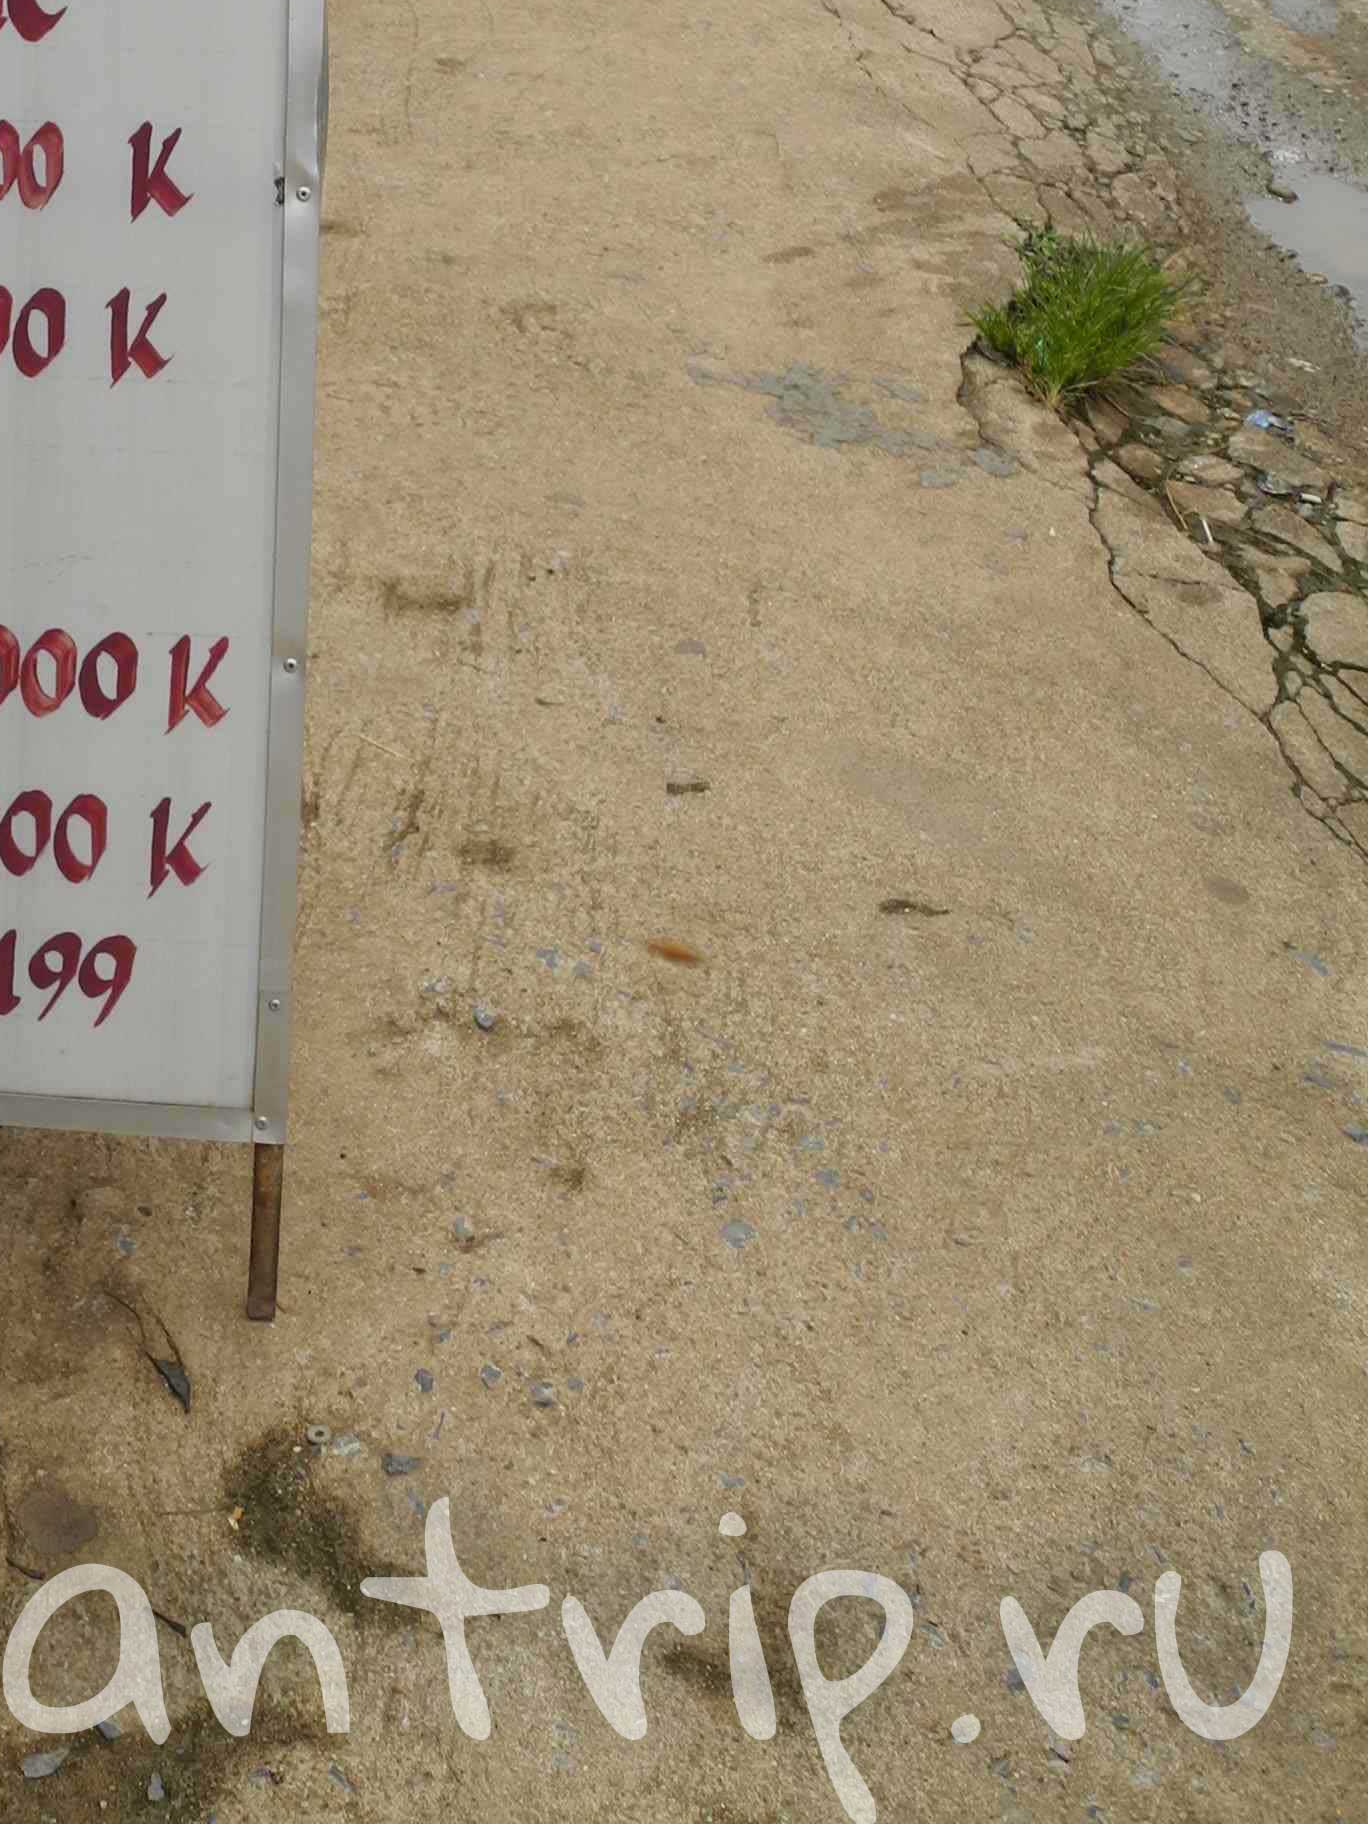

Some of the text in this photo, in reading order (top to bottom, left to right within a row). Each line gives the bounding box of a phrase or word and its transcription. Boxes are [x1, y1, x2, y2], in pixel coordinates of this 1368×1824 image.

[126, 121, 194, 222] K
[105, 287, 174, 388] K
[164, 634, 230, 734] K
[145, 798, 212, 899] K
